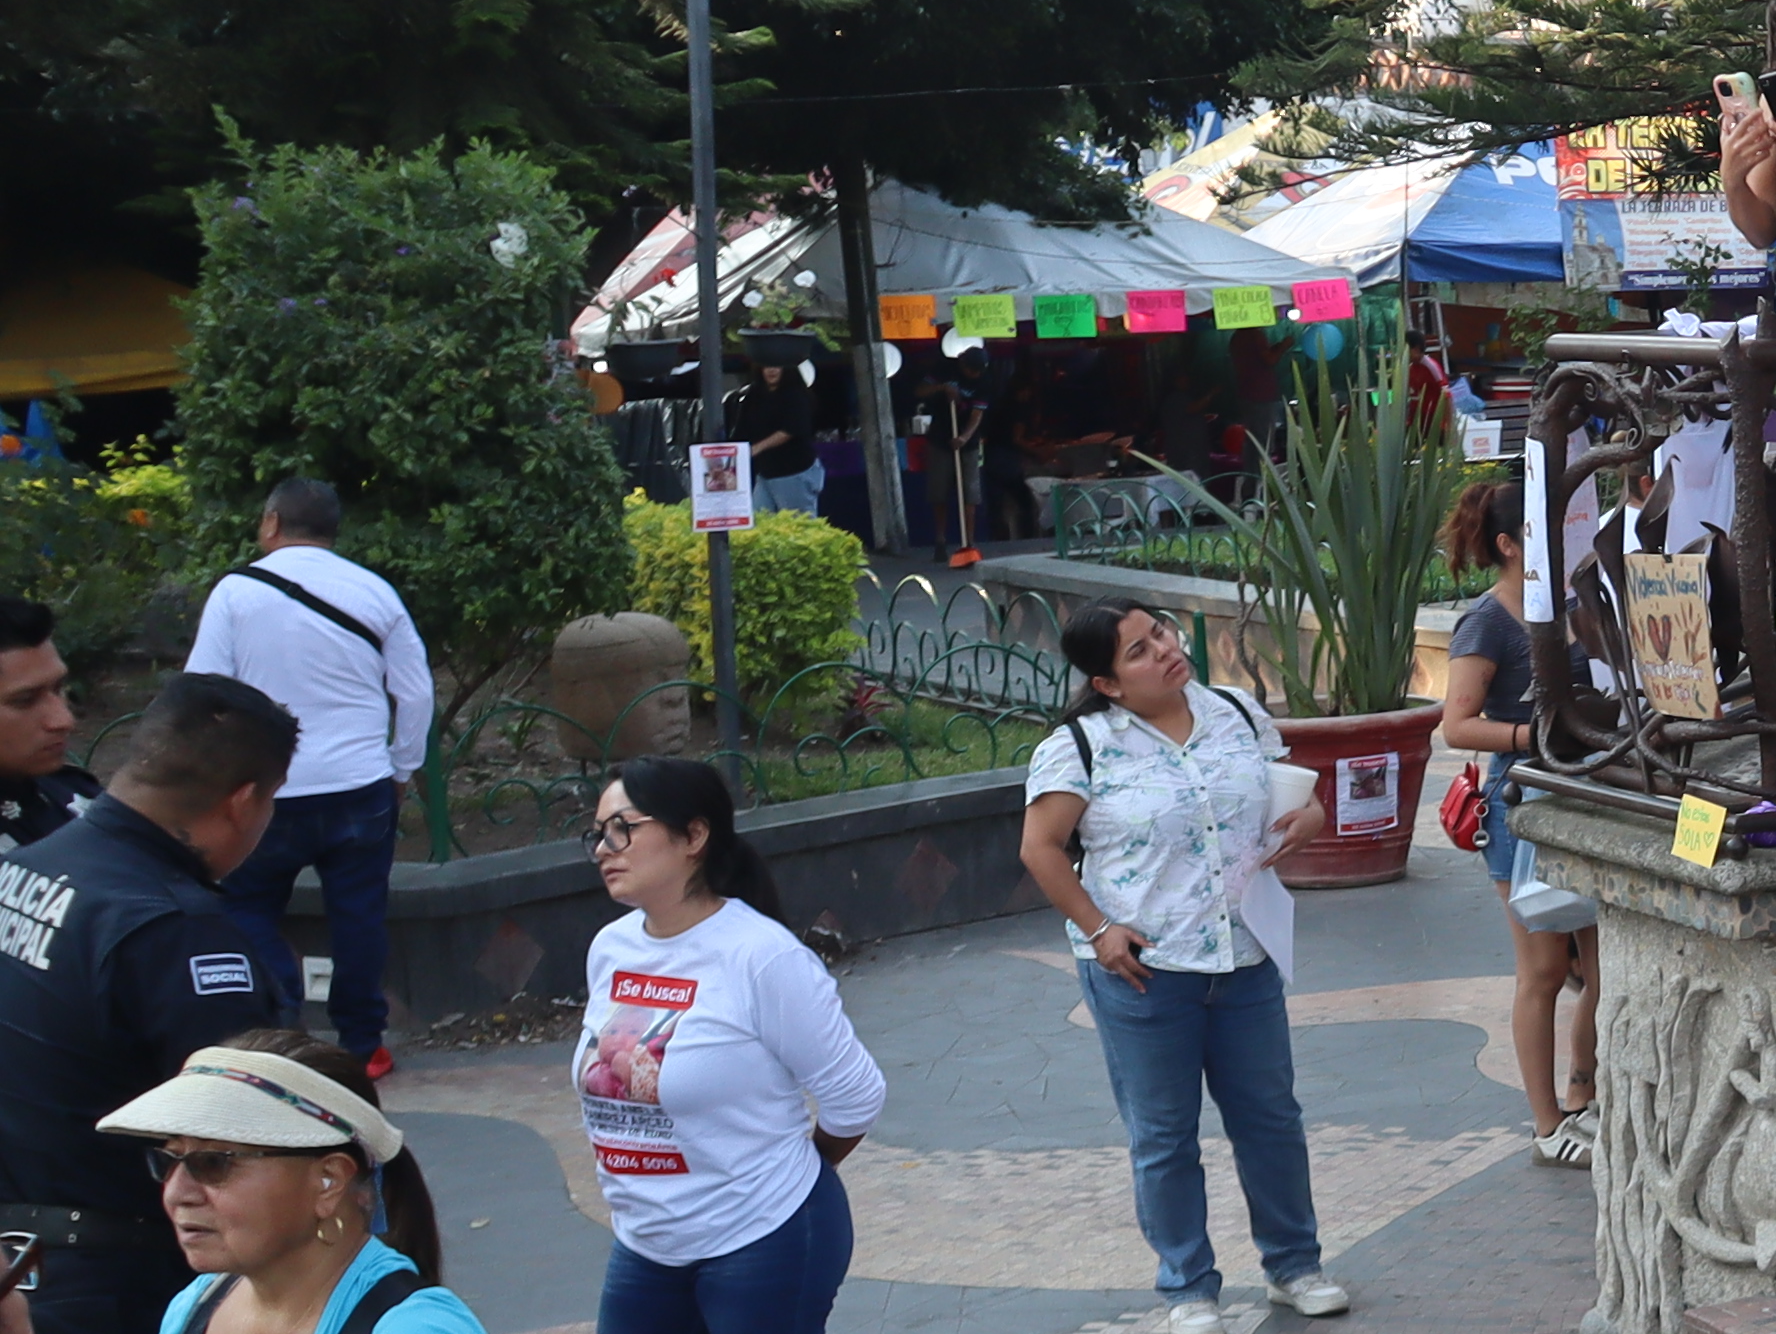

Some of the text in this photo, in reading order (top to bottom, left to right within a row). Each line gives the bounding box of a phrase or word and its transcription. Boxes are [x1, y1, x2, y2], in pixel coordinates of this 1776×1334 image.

[1587, 158, 1627, 193] DE
[1621, 201, 1636, 213] LA
[1700, 200, 1716, 213] DE
[200, 972, 248, 985] SOCIAL
[615, 978, 693, 1003] ¡Se busca!
